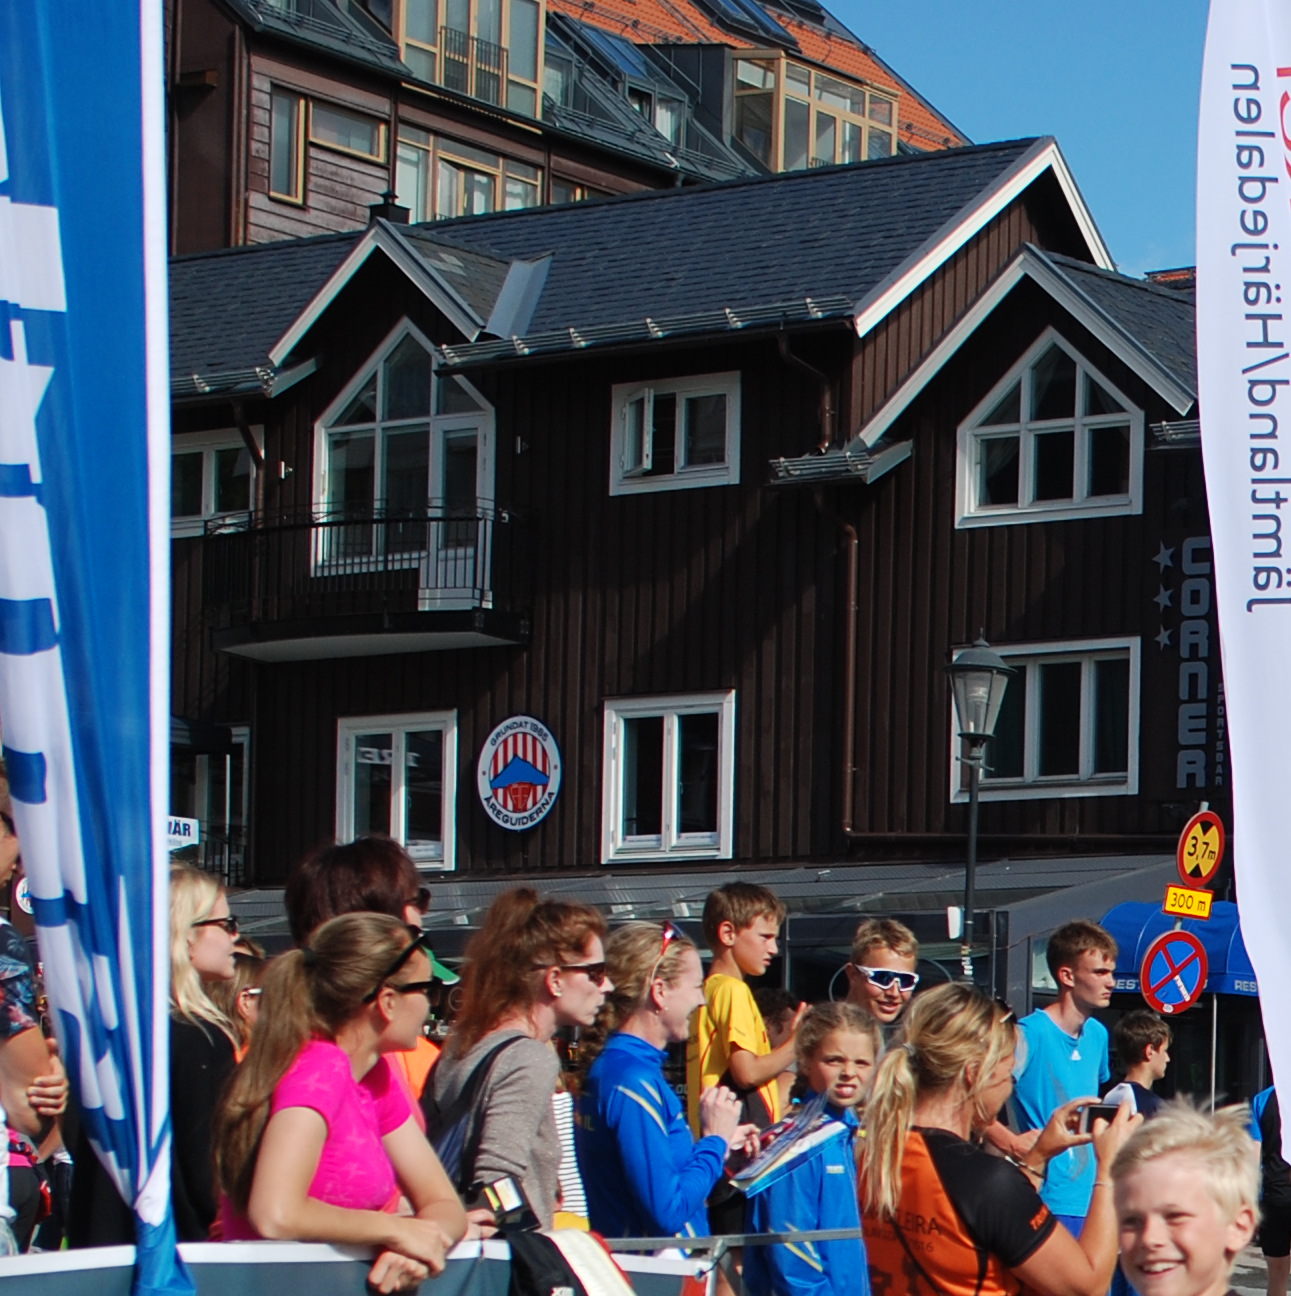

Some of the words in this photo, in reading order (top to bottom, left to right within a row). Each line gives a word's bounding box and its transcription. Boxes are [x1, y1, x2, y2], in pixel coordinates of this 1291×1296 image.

[1176, 535, 1211, 789] CORNER
[490, 721, 529, 747] GRUNDAT
[1215, 682, 1225, 786] SPORTSBAR
[484, 791, 556, 827] ÅREGUIDERNA
[168, 819, 191, 836] ÄR
[1170, 892, 1195, 910] 300
[1197, 900, 1206, 911] m
